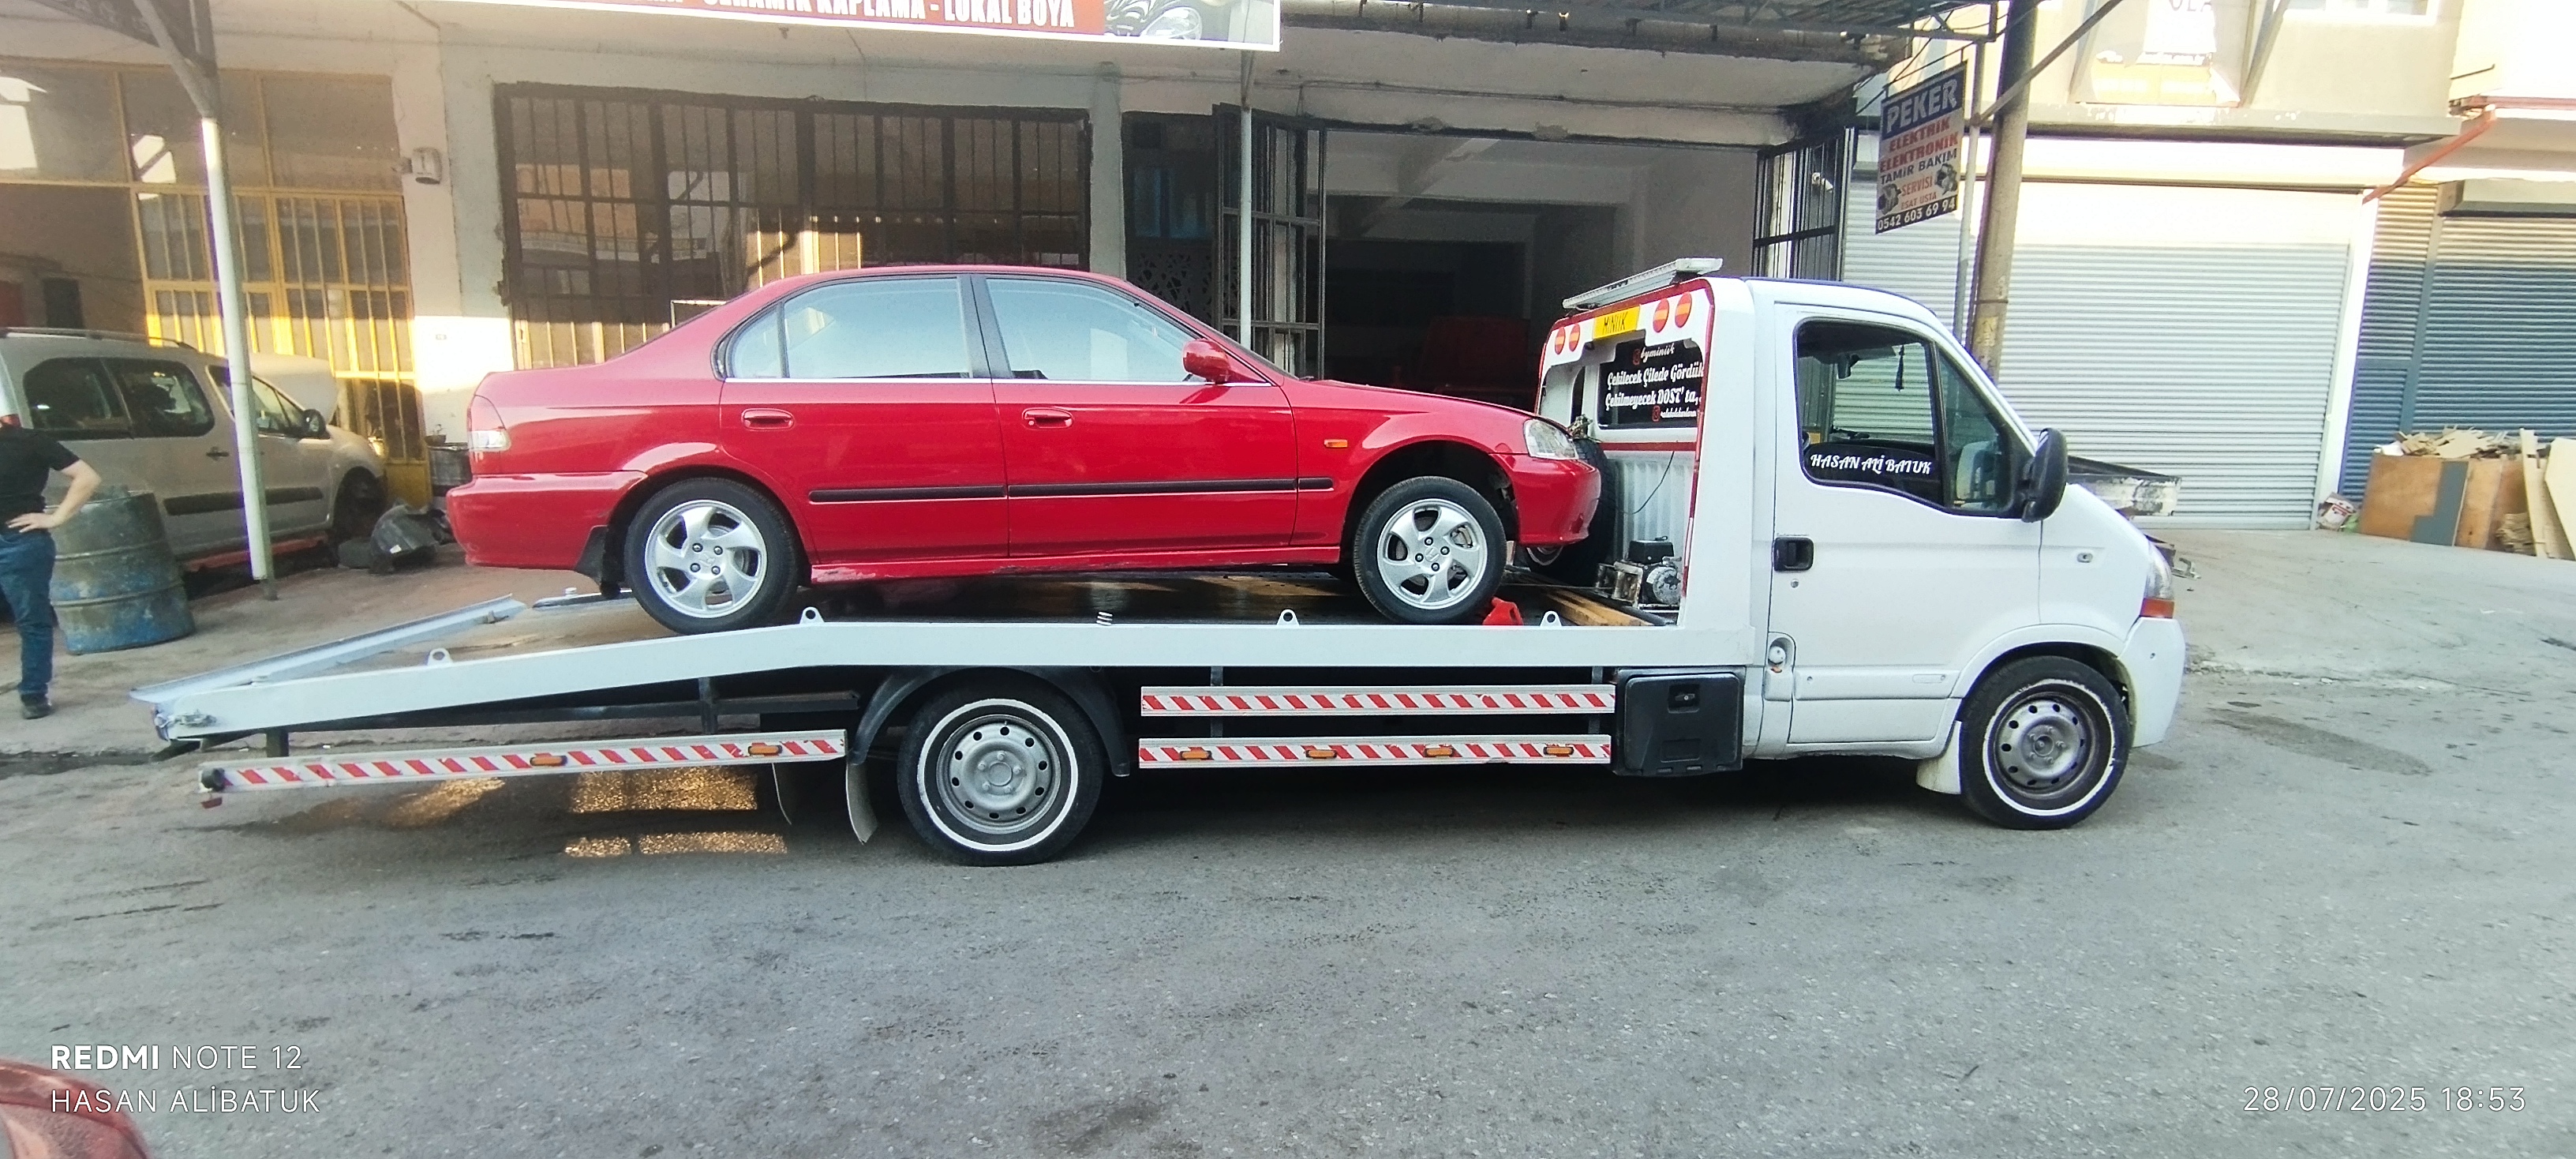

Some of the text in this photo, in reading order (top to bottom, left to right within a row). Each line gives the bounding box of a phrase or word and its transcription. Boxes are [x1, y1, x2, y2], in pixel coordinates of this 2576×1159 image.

[944, 0, 1012, 24] LOKAL
[1017, 0, 1074, 27] BOYA
[1887, 79, 1957, 133] PEKER
[1919, 148, 1957, 171] BAKIM
[1878, 197, 1956, 231] 0542 603 69 94
[1607, 362, 1705, 390] Çekilecek Çilede Gördük
[1605, 391, 1657, 411] Çekilmeyecek
[1810, 454, 1860, 469] HASAN
[1861, 454, 1885, 474] ALİ
